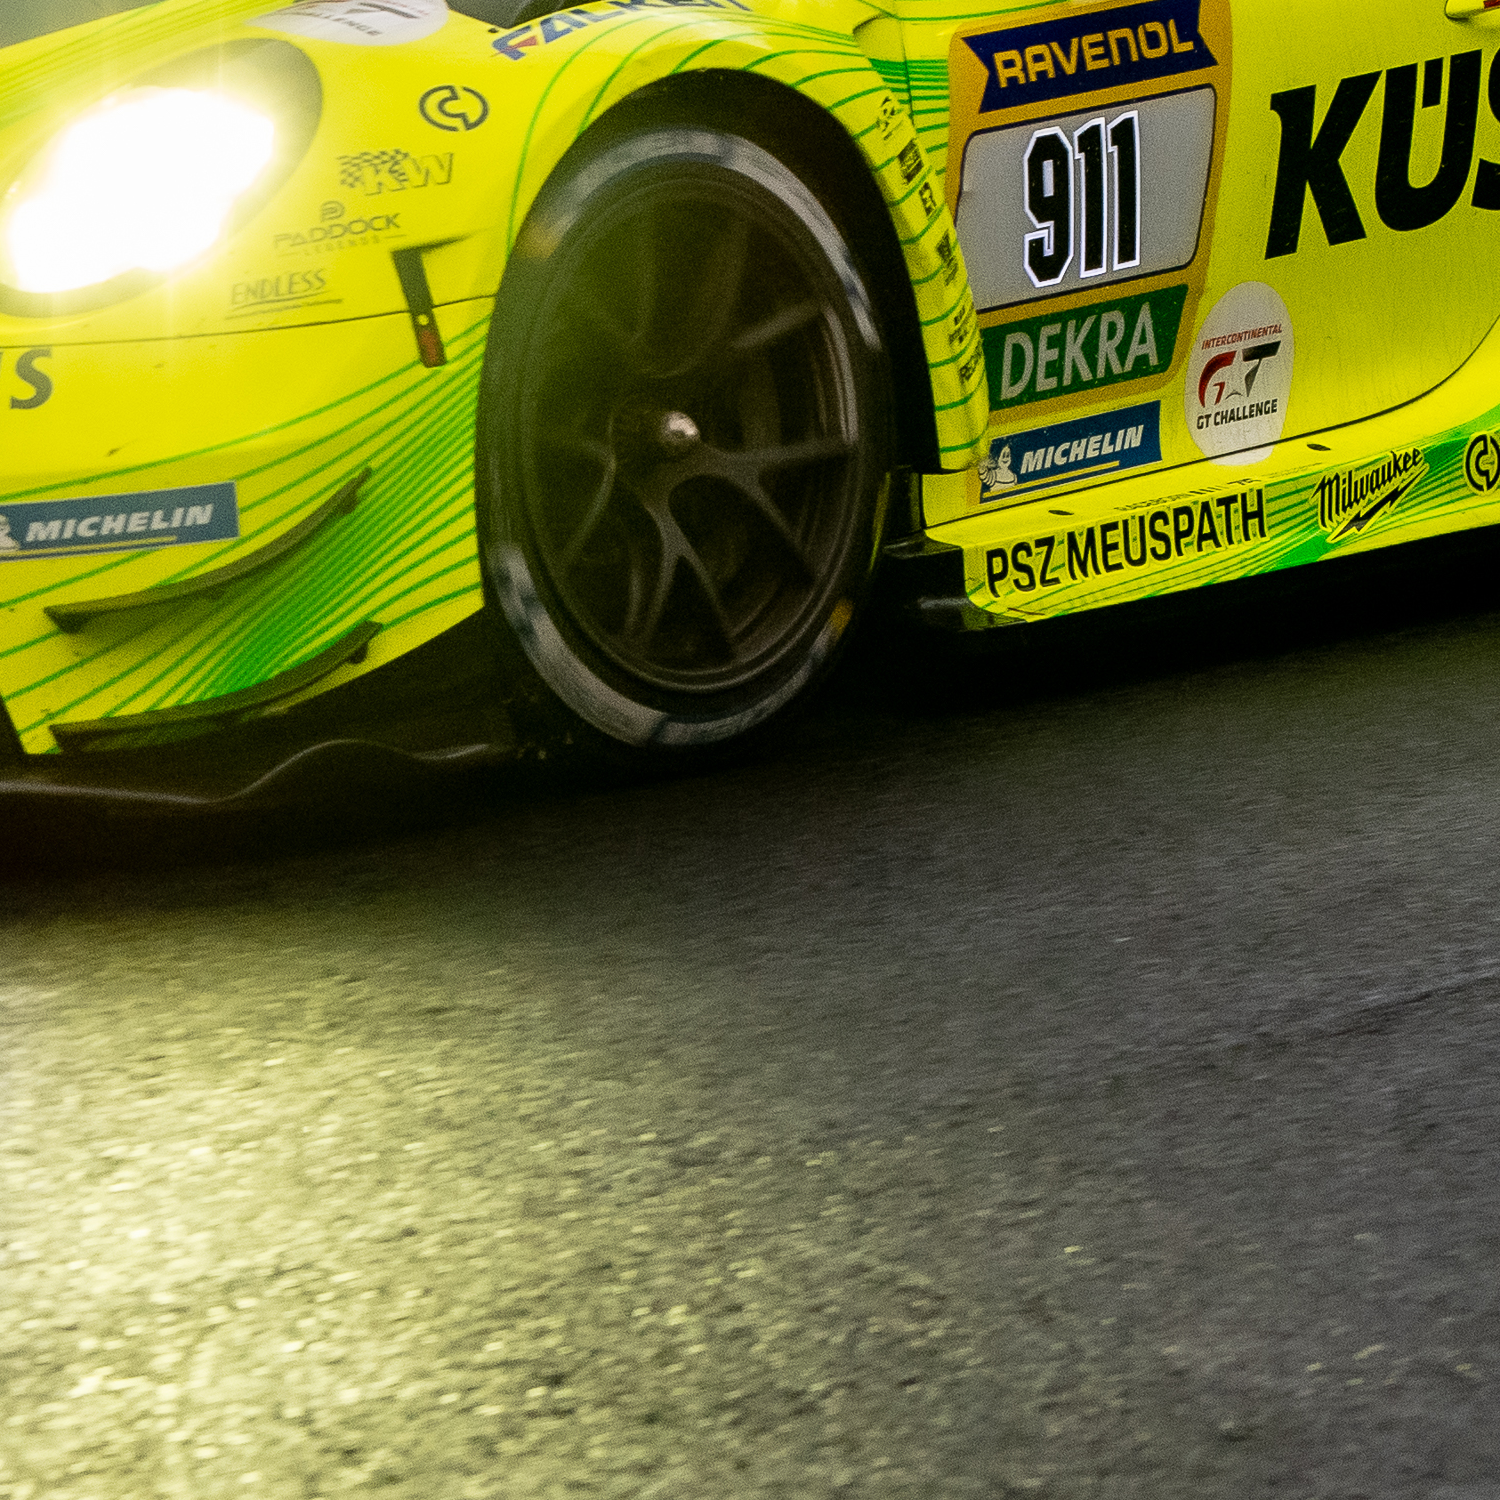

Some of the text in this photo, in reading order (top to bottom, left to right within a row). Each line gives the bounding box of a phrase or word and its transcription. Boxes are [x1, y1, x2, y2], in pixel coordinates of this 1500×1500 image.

[993, 18, 1195, 89] RAVENOL
[1023, 110, 1142, 288] 911
[274, 212, 402, 249] PADDOCK
[231, 268, 327, 306] ENDLESS
[1000, 301, 1160, 401] DEKRA
[1196, 398, 1279, 430] GT CHALLENGE
[1019, 424, 1145, 475] MICHELIN
[1311, 448, 1423, 528] Milwaukee
[25, 502, 215, 544] MICHELIN
[985, 536, 1061, 598] PSZ
[1067, 489, 1267, 581] MEUSPATH
